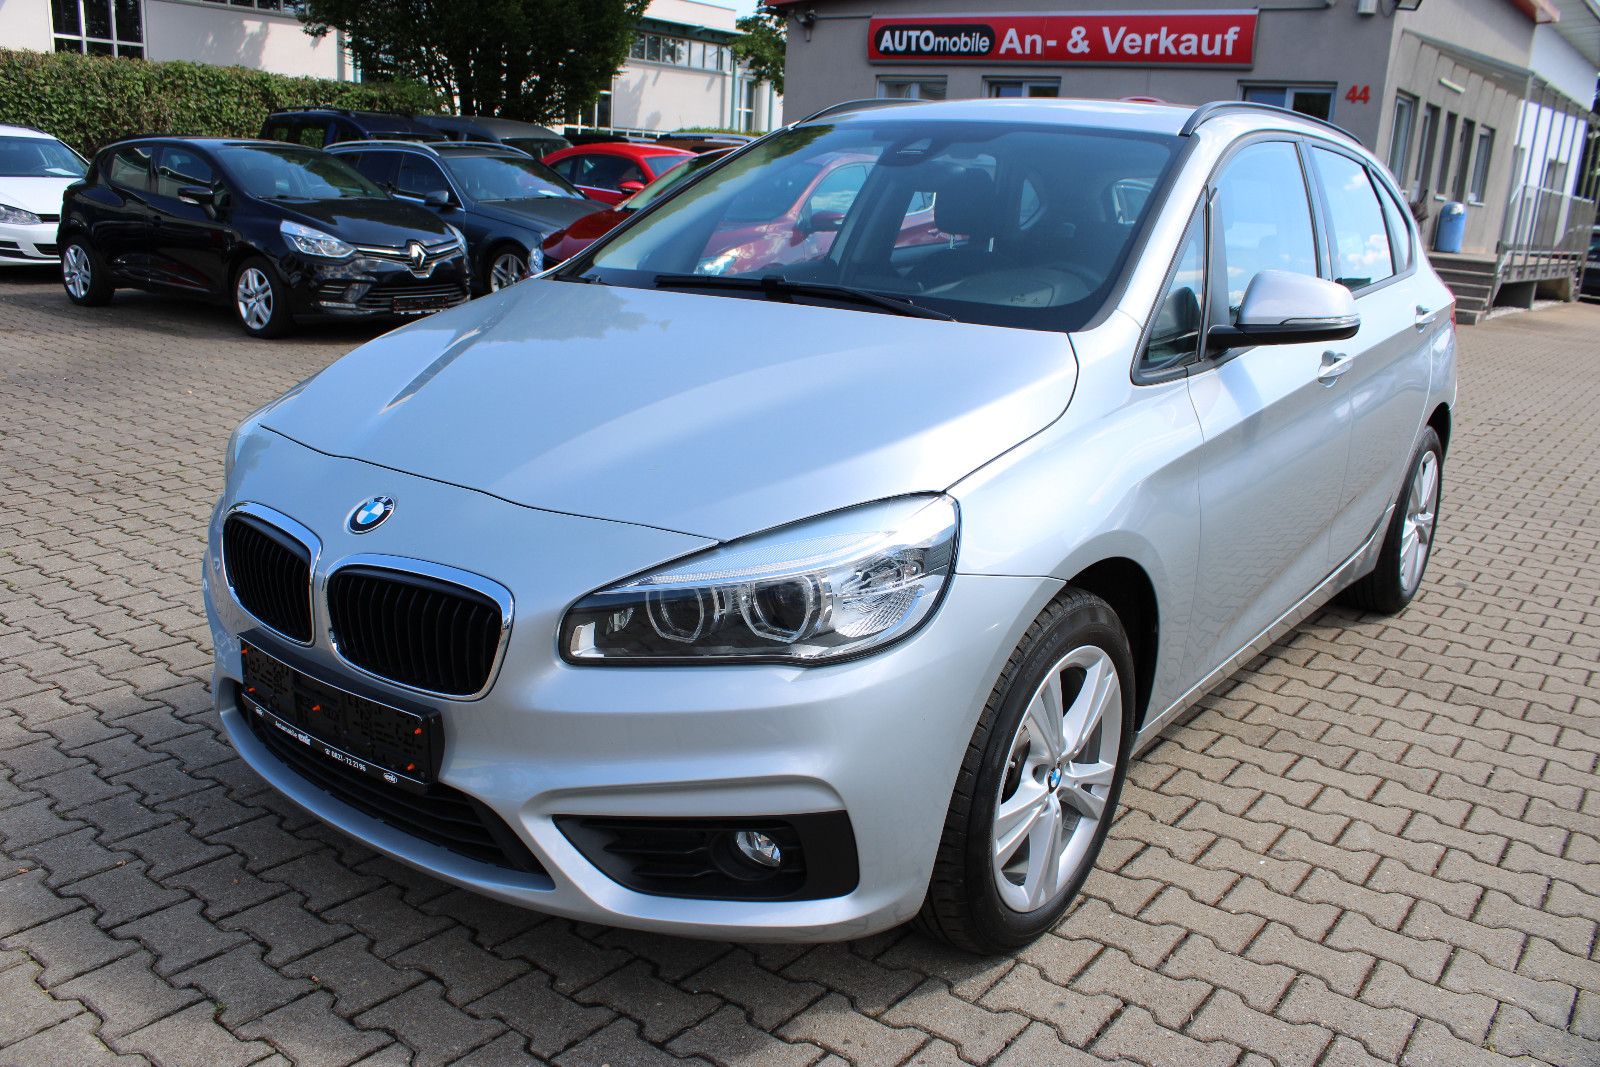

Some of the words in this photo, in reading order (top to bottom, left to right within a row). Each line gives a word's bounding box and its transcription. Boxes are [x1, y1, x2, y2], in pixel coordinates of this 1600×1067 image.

[879, 30, 990, 53] AUTOmobile
[999, 28, 1057, 54] An-
[1066, 26, 1090, 54] &
[1102, 26, 1241, 56] Verkauf
[1345, 84, 1370, 105] 44
